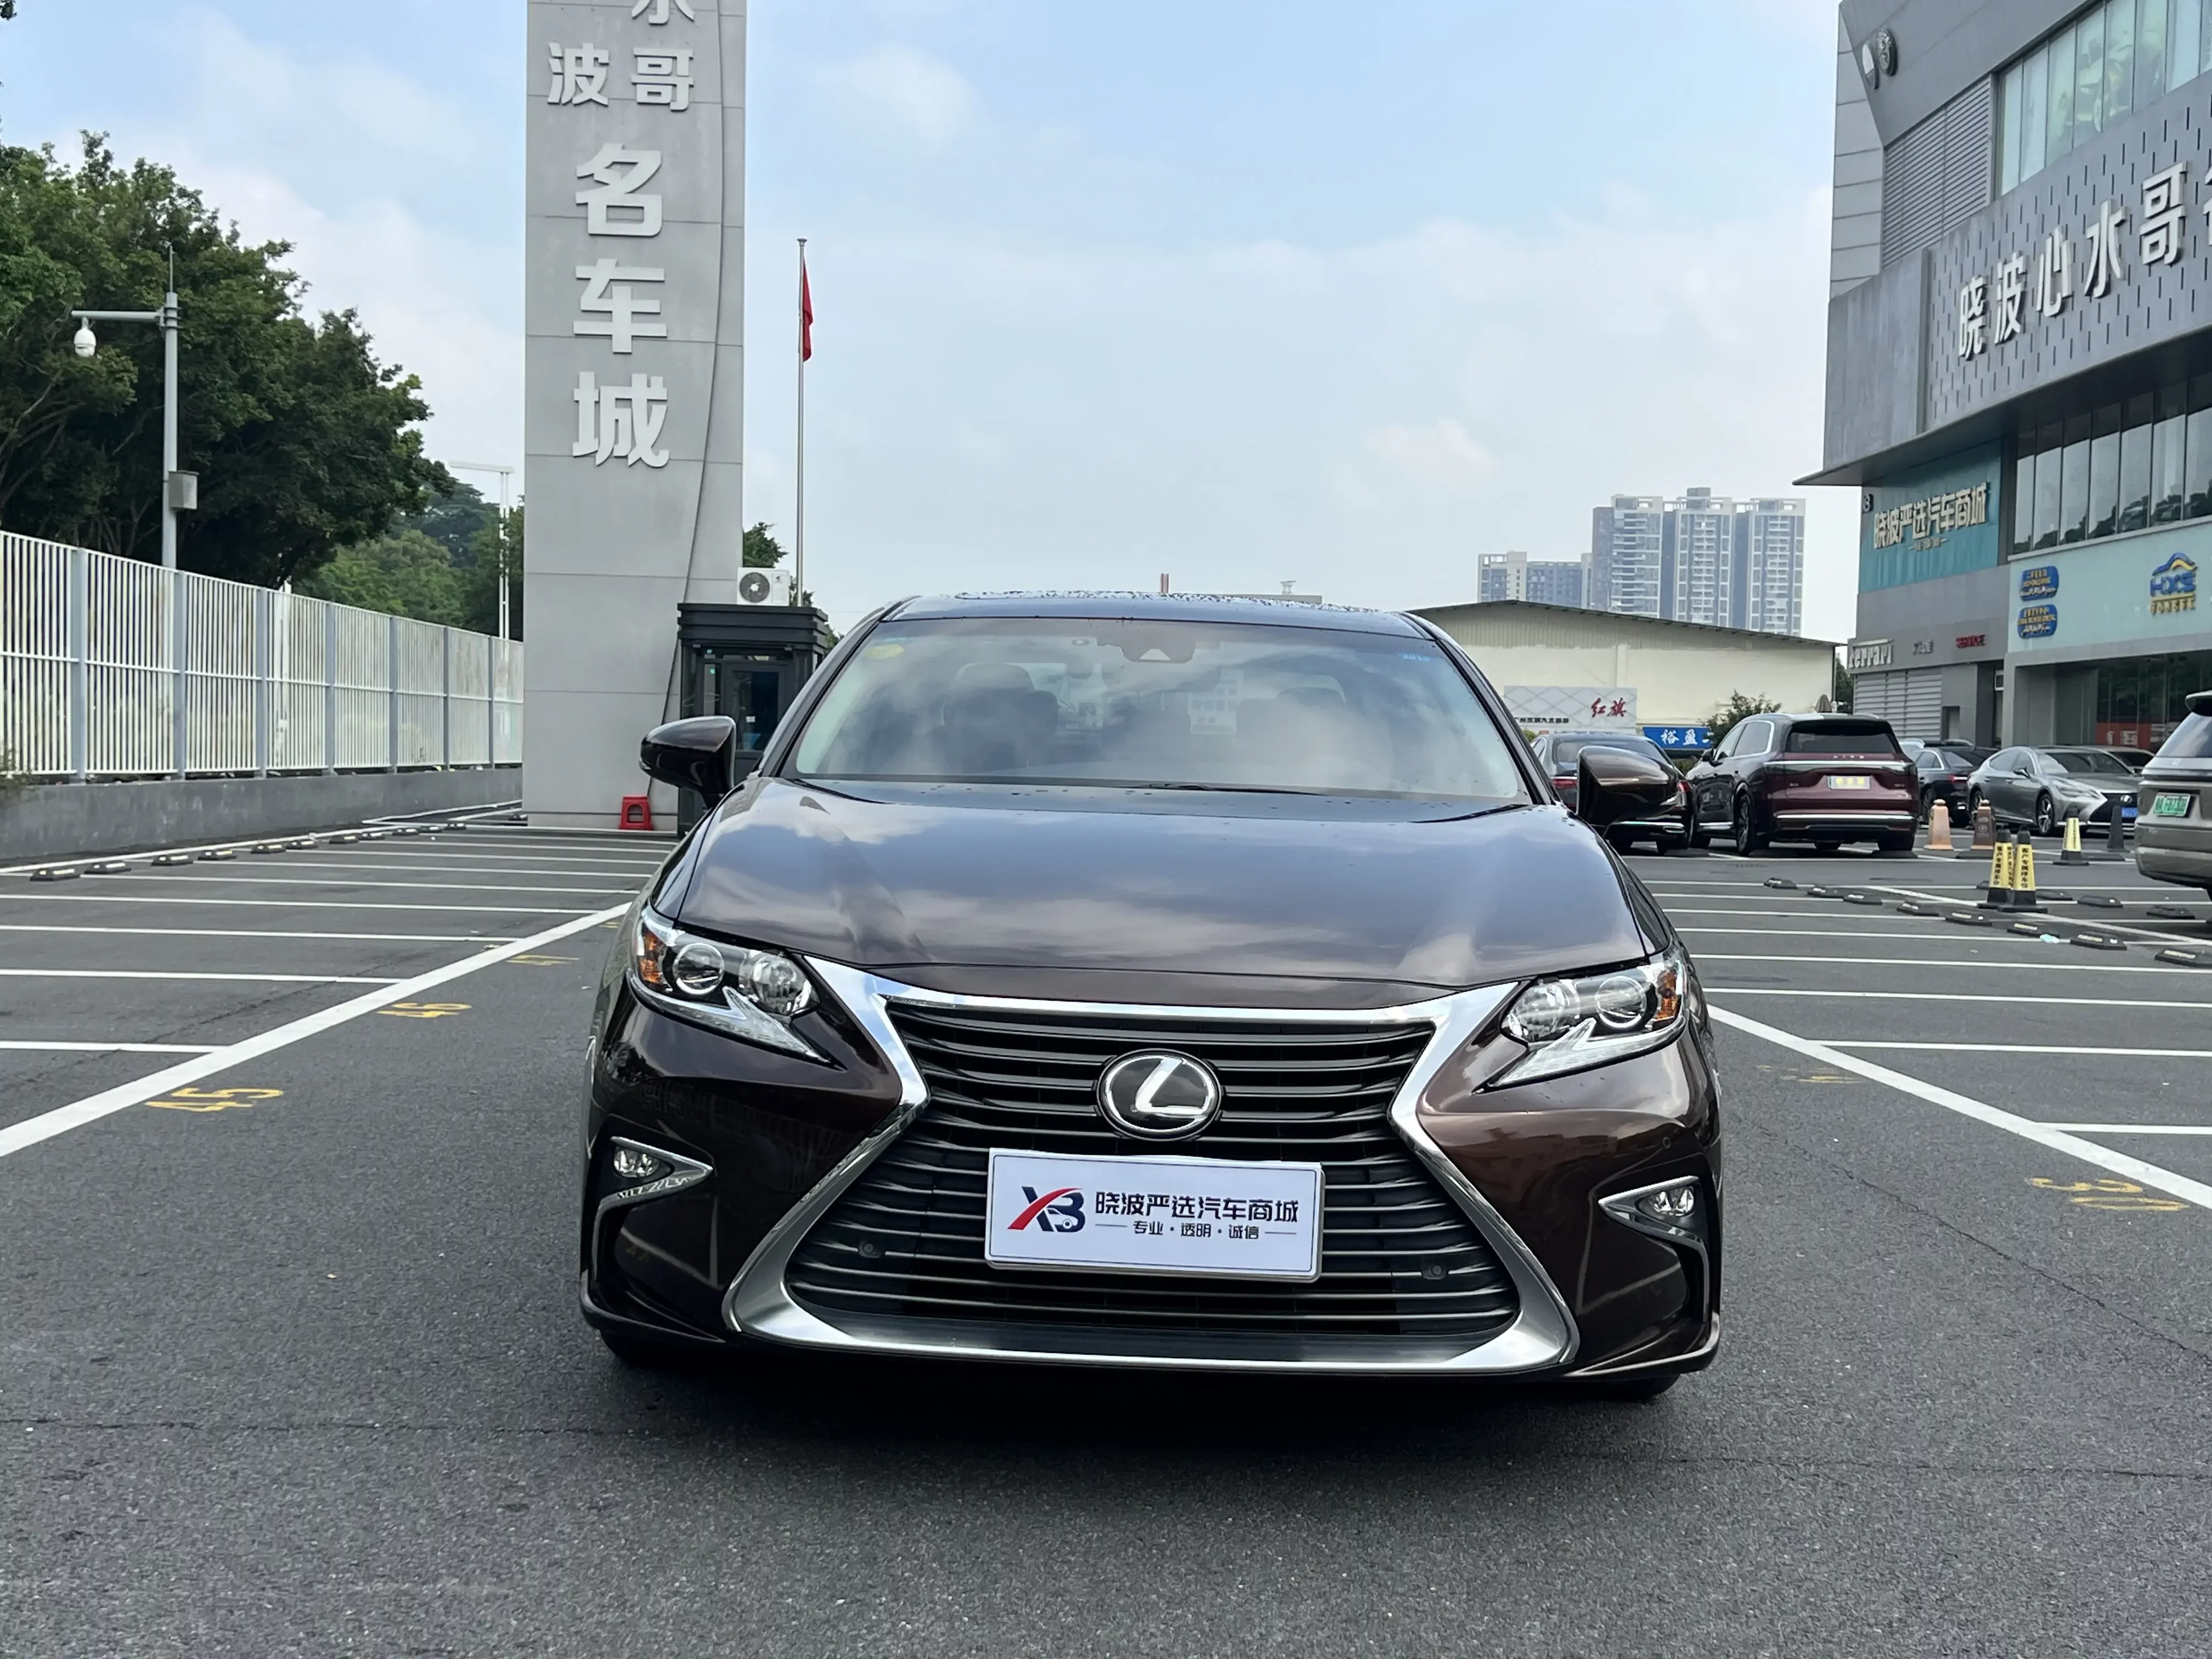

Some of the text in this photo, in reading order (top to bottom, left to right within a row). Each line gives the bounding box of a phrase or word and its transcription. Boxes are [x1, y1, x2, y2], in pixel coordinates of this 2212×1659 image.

[1958, 161, 2212, 360] 晓波心水哥
[572, 143, 670, 467] 名车城
[1874, 482, 1987, 549] 晓波严选汽车商城
[1590, 697, 1627, 718] 红旗
[376, 1002, 472, 1018] 46
[144, 1087, 284, 1112] 45
[1095, 1190, 1299, 1223] 晓波严选汽车商城
